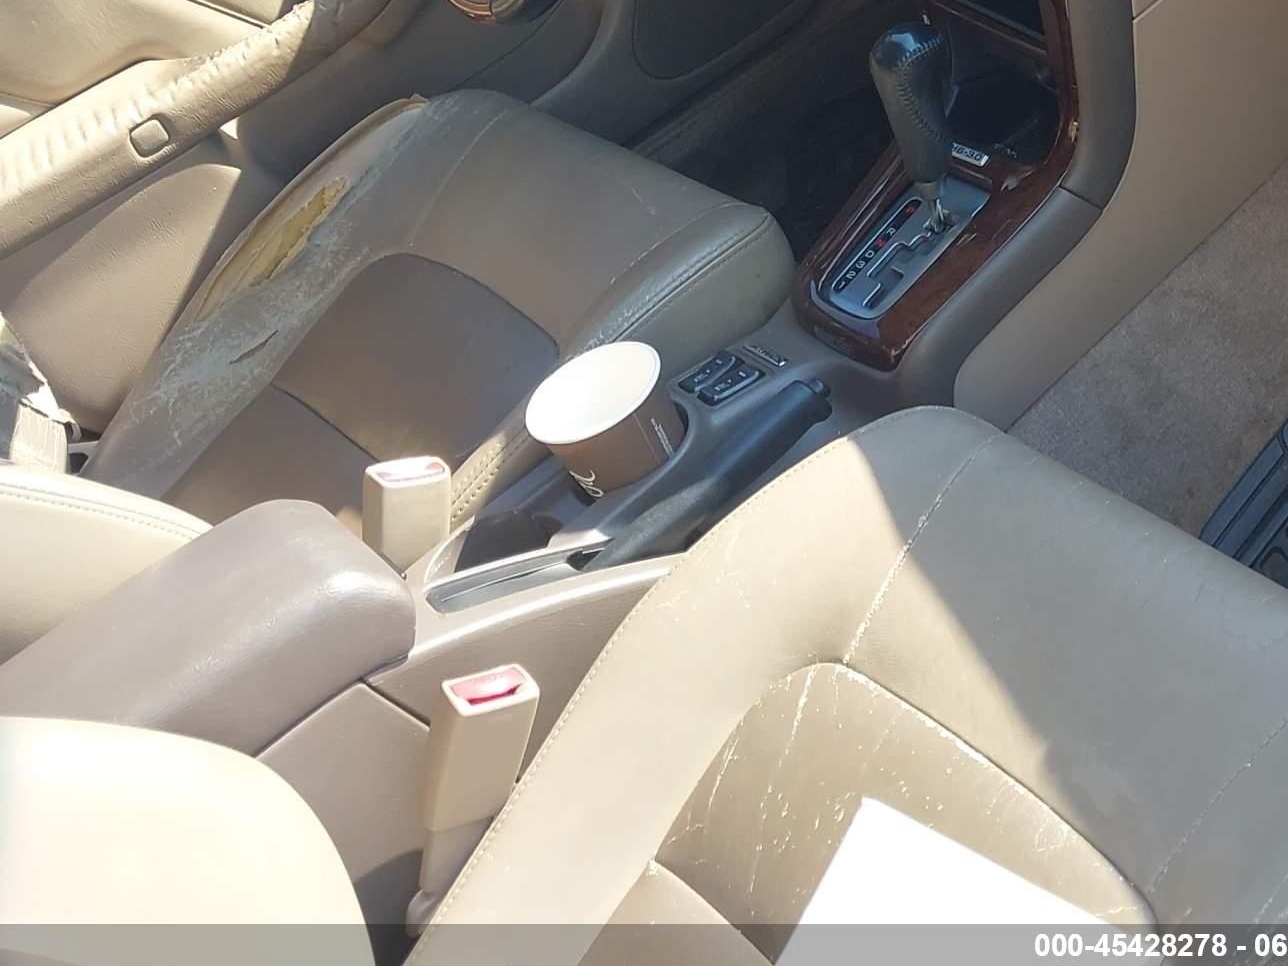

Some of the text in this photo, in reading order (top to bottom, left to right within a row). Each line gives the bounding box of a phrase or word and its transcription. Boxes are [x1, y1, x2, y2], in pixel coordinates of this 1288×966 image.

[865, 249, 875, 258] D
[855, 260, 866, 269] 3
[846, 271, 857, 280] 2
